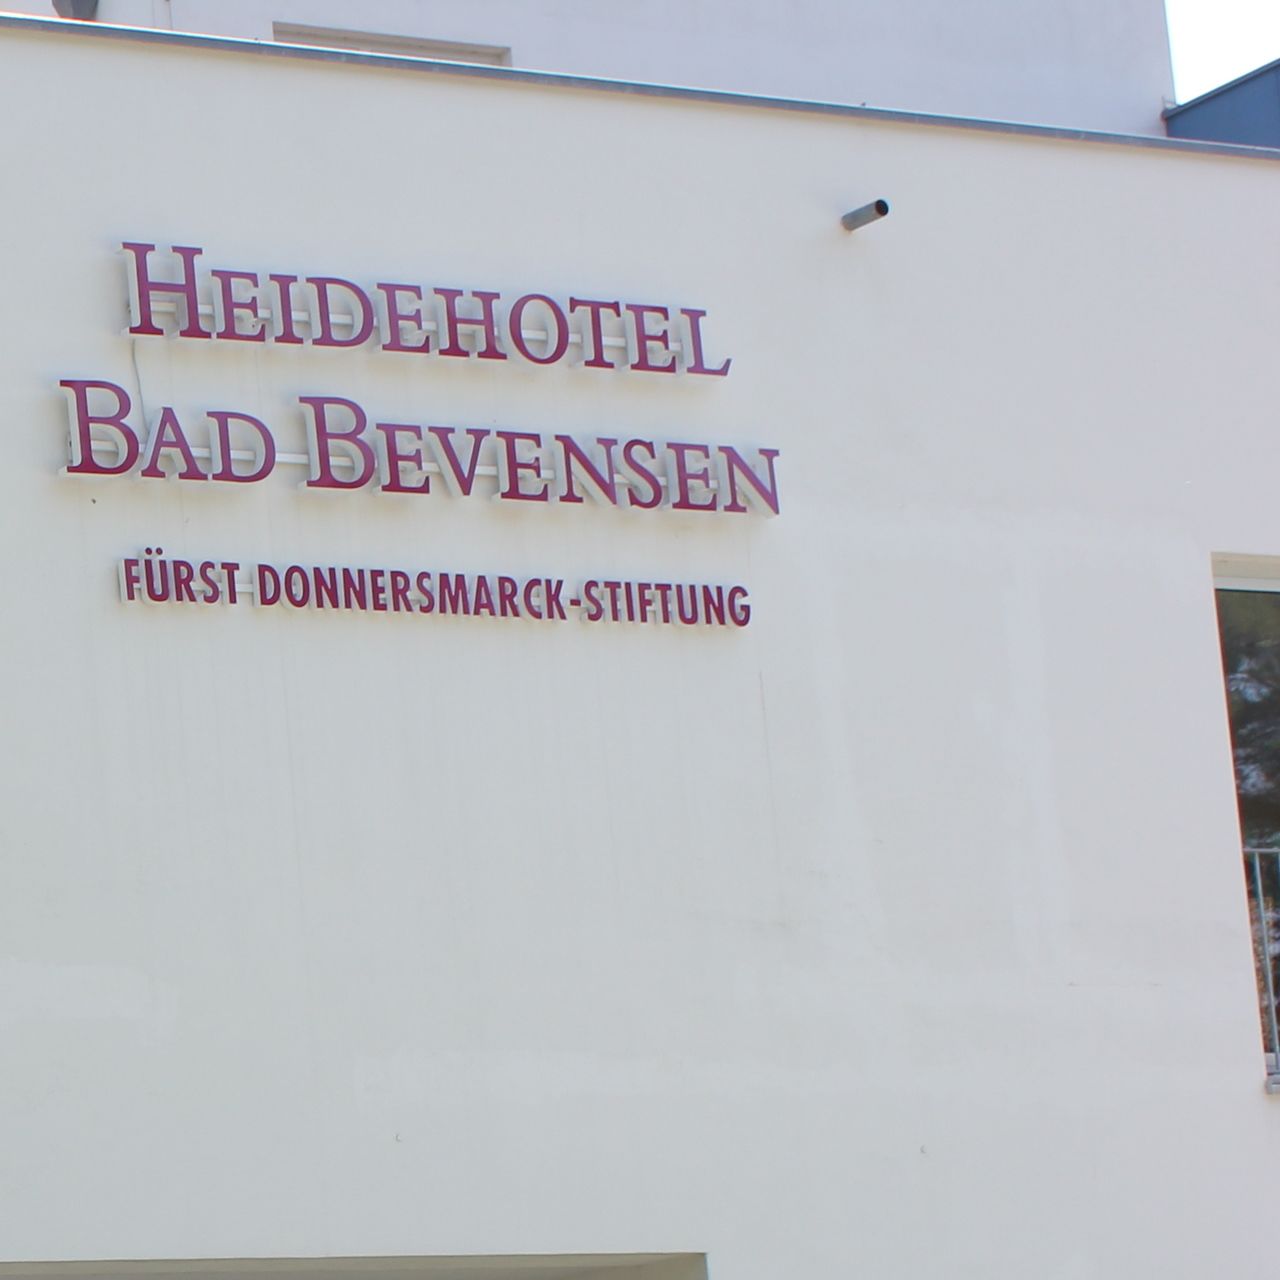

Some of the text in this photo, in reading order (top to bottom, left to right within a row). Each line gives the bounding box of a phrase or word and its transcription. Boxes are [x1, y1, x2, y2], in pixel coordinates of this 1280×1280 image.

[121, 241, 732, 377] HEIDEHOTEL
[59, 380, 780, 515] BAD BEVENSEN
[122, 548, 752, 627] FÜRST DONNERSMARCK-STIFTUNG
